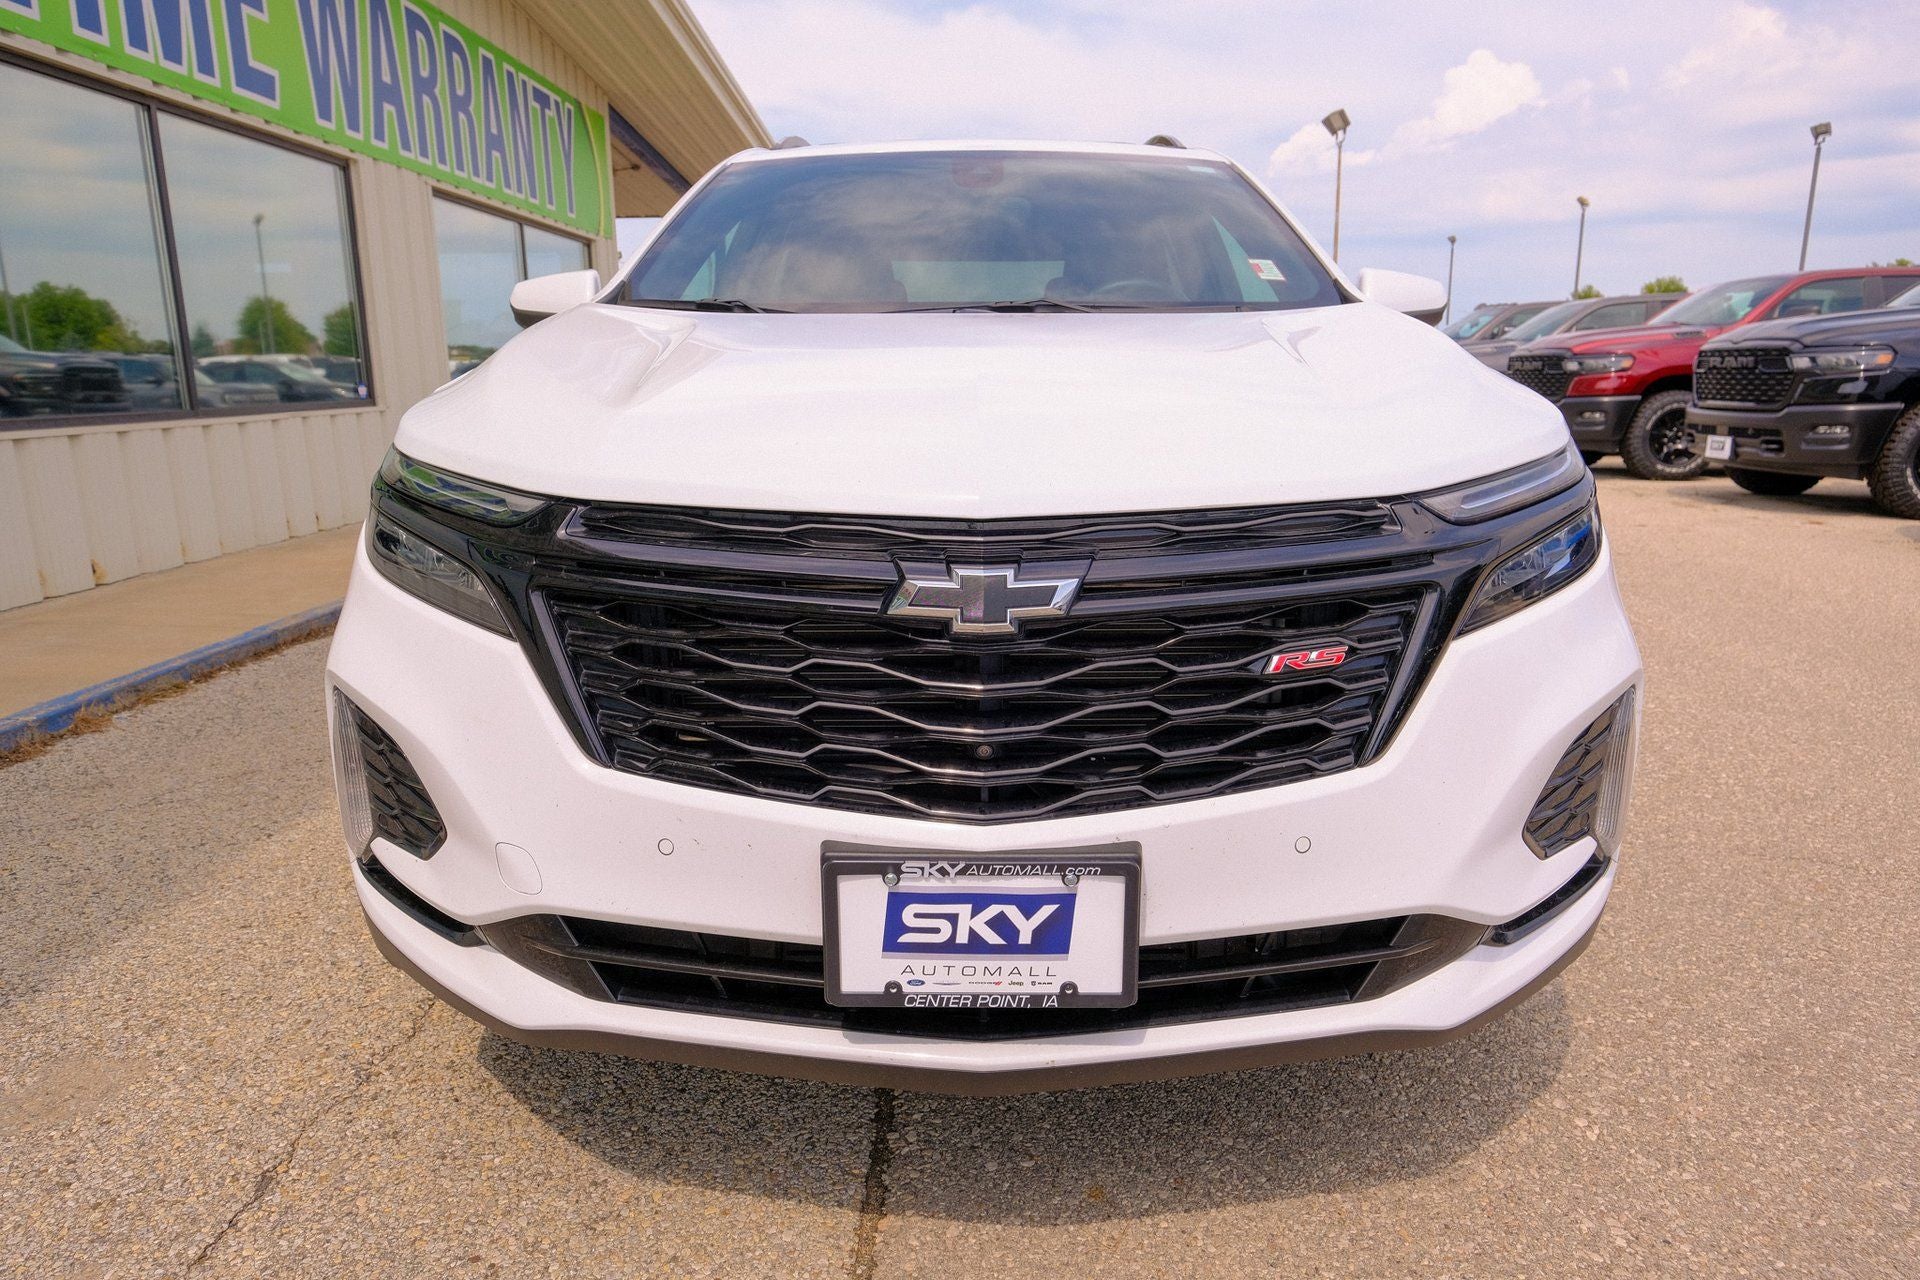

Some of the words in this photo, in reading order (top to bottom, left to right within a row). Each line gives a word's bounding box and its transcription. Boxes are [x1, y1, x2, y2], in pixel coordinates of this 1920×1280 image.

[295, 0, 576, 218] WARRANTY
[1709, 356, 1755, 369] RAM
[1265, 645, 1348, 675] RS
[900, 861, 966, 878] SKY
[966, 865, 1101, 876] AUTOMALL.com
[897, 903, 1061, 945] SKY
[901, 964, 1057, 977] AUTOMALL
[904, 995, 973, 1008] CENTER
[976, 995, 1031, 1009] POINT,
[1042, 995, 1059, 1008] IA
